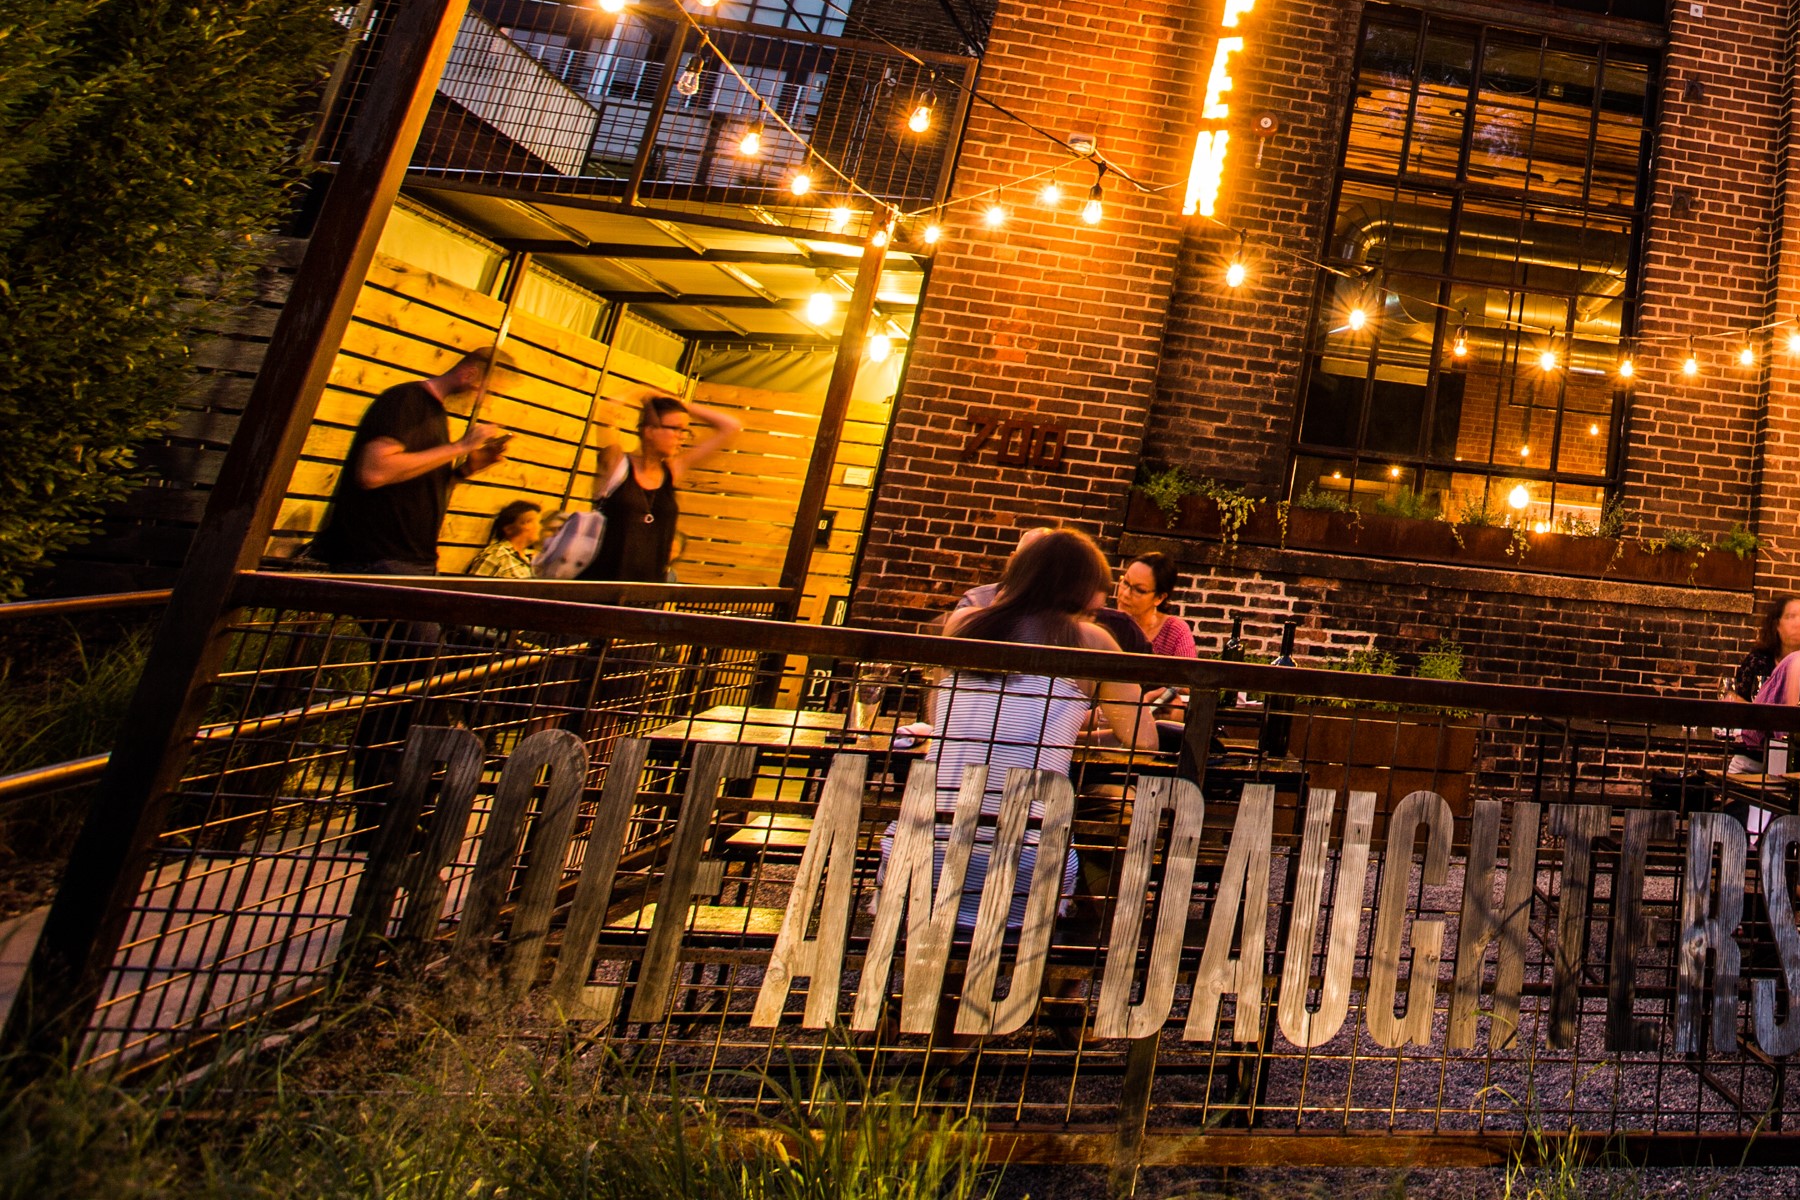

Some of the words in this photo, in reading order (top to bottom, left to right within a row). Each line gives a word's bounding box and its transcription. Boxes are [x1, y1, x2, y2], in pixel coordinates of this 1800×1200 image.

[961, 417, 1066, 468] 700
[337, 724, 758, 1022] ROLF
[750, 753, 1075, 1035] AND
